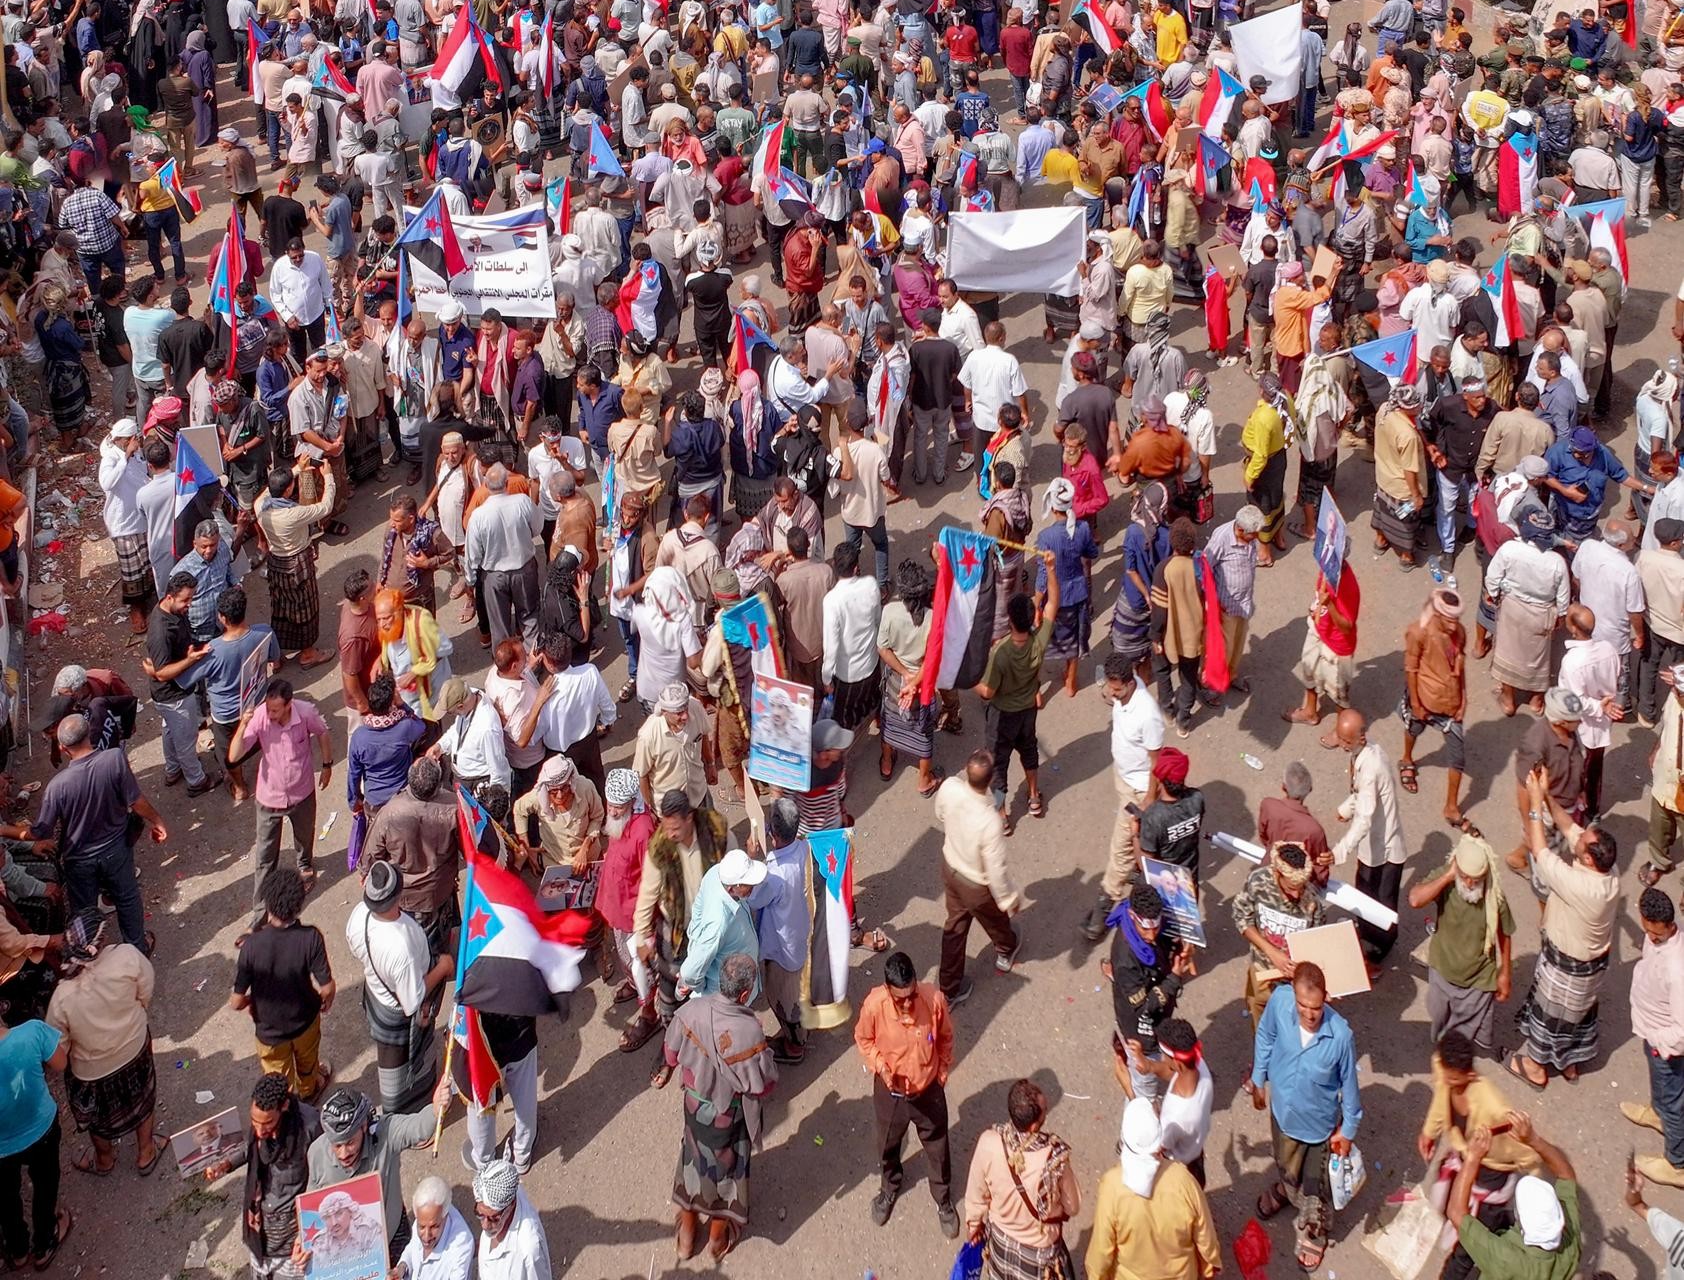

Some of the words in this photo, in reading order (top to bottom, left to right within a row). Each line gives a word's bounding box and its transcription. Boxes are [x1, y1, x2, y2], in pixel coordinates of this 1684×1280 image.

[484, 260, 514, 273] سلطات
[505, 288, 530, 302] المجلس
[531, 286, 553, 301] مقرات
